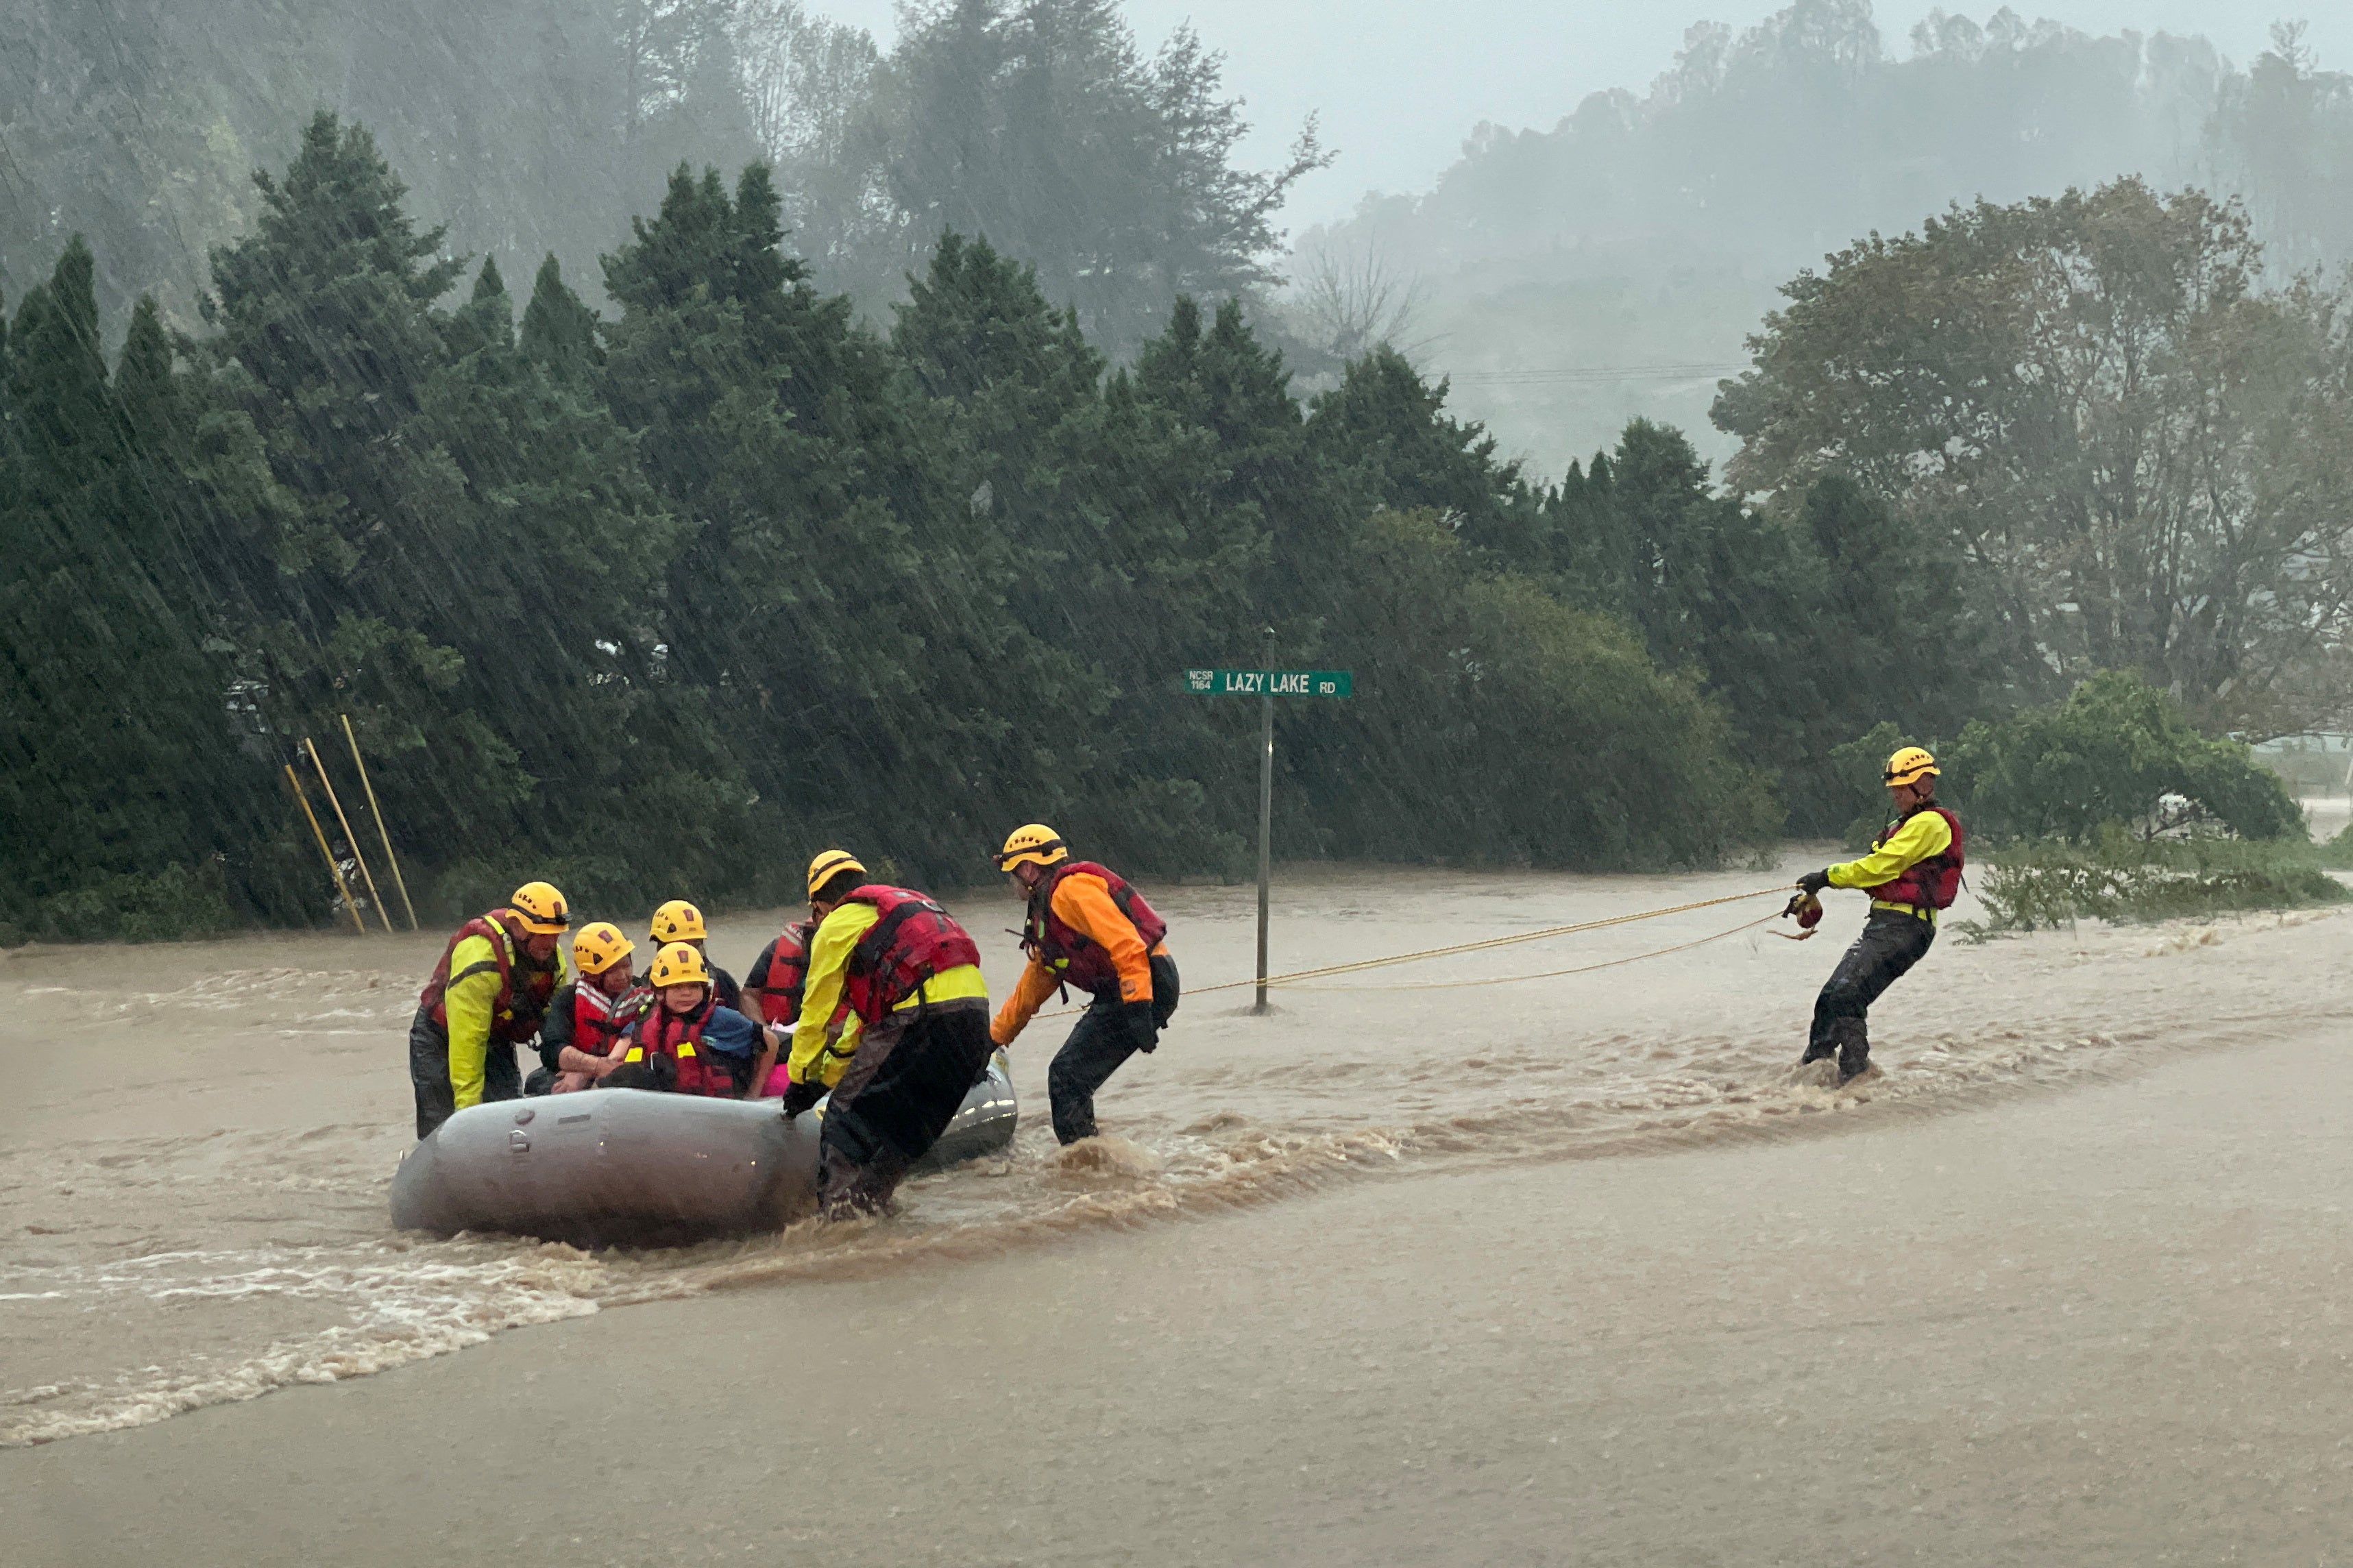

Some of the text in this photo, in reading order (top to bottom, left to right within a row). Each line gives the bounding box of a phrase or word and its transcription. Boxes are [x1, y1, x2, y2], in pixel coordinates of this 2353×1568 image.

[1189, 670, 1213, 680] NCSR
[1226, 673, 1336, 694] LAZY LAKE RD
